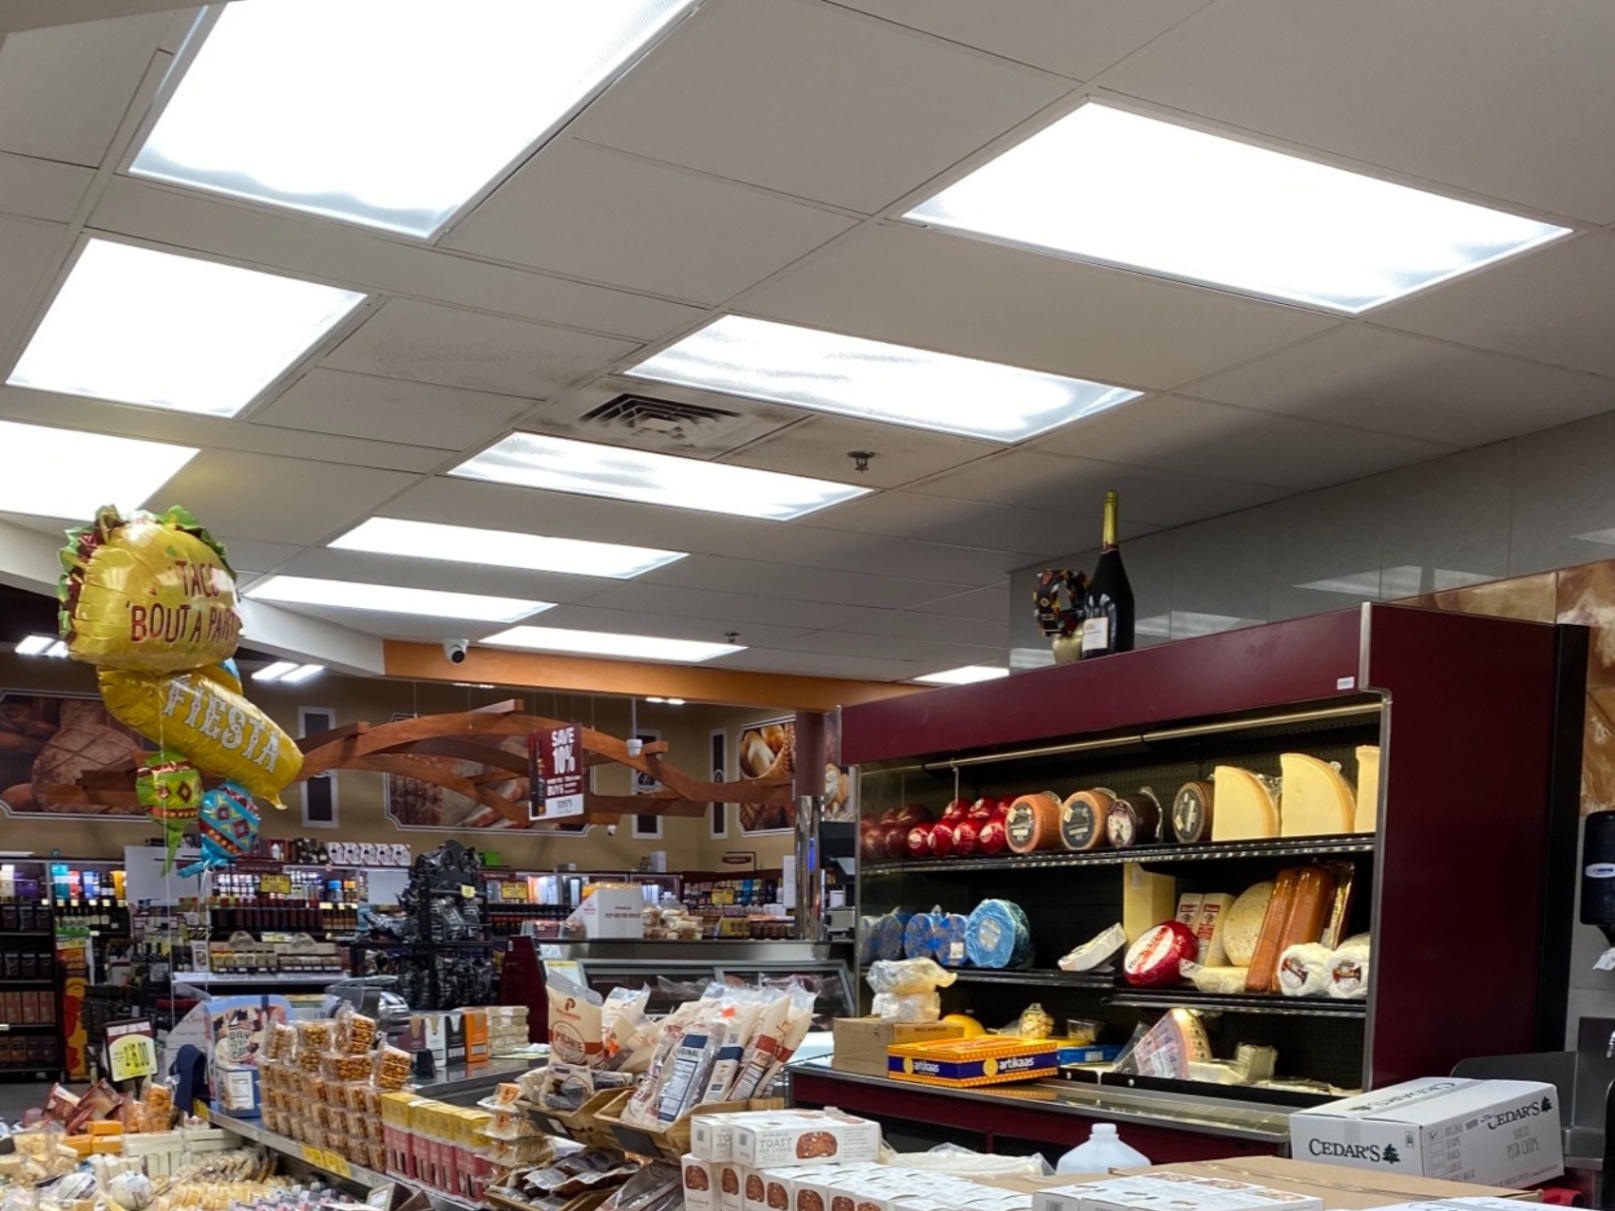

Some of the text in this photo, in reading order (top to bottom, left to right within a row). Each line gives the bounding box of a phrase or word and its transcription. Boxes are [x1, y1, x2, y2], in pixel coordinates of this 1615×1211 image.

[189, 610, 202, 643] A
[207, 607, 240, 642] PART
[163, 677, 281, 773] FIESTA
[551, 727, 575, 747] SAVE
[552, 744, 576, 774] 10%
[999, 1057, 1035, 1070] artikaas
[1488, 1101, 1540, 1130] CEDAR'S
[759, 1137, 792, 1148] TOAST
[1309, 1138, 1381, 1162] CEDAR'S
